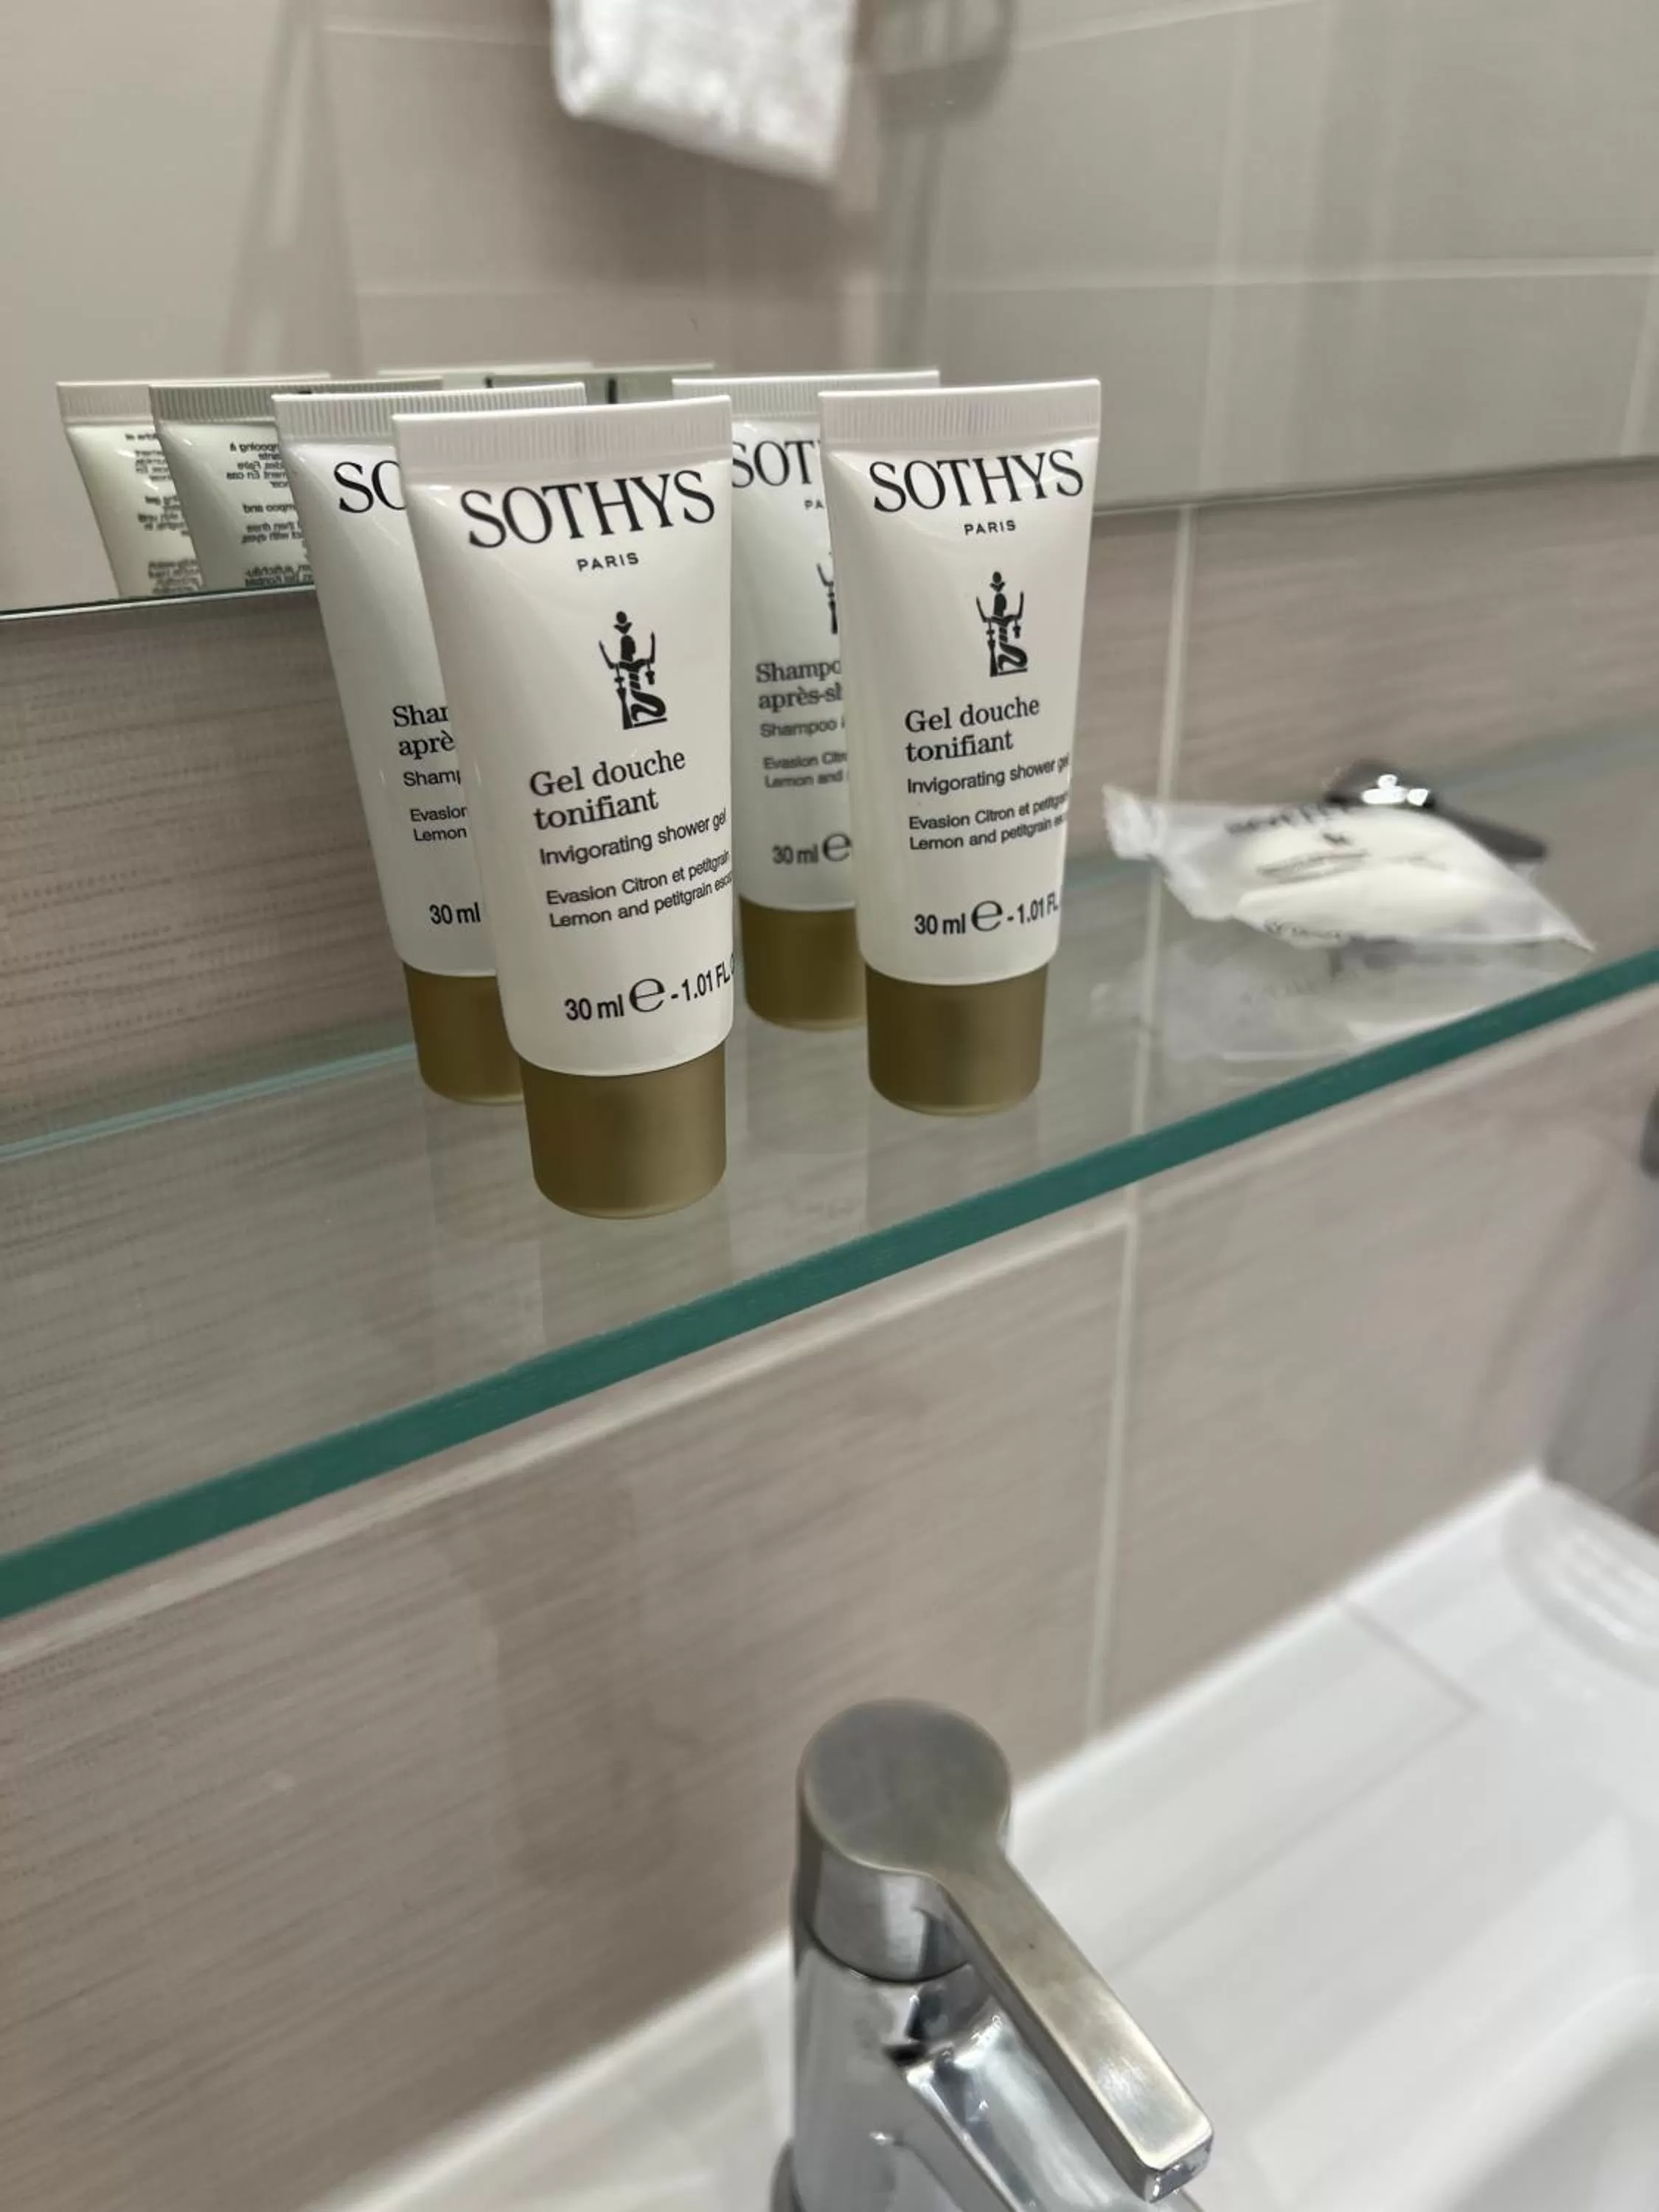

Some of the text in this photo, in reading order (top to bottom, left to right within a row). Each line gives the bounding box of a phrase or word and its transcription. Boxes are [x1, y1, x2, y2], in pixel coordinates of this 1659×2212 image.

[731, 439, 820, 488] SOT
[869, 449, 1084, 512] SOTHYS
[460, 470, 715, 548] SOTHYS
[964, 519, 1016, 535] PARIS
[577, 552, 639, 571] PARIS
[759, 718, 838, 737] Shampoo
[905, 695, 1040, 733] Gel douche
[399, 730, 456, 760] aprè
[905, 729, 1014, 762] tonifiant
[403, 769, 461, 787] Sham
[530, 750, 686, 796] Gel douche
[908, 771, 1005, 795] Invigorating
[1010, 758, 1056, 781] shower
[534, 787, 659, 830] tonifiant
[908, 814, 970, 830] Evasion
[975, 807, 1015, 825] Citron
[414, 827, 467, 841] Lemon
[540, 807, 727, 865] Invigorating shower gel
[910, 837, 964, 850] Lemon
[969, 830, 997, 846] and
[772, 844, 793, 864] 30
[796, 844, 818, 864] ml
[546, 884, 616, 905] Evasion
[622, 872, 667, 894] Citron
[672, 867, 685, 883] et
[429, 902, 481, 925] 30 ml
[549, 910, 612, 928] Lemon
[618, 900, 650, 919] and
[655, 883, 713, 914] petitgrain
[914, 914, 939, 935] 30
[942, 912, 966, 935] ml
[564, 998, 592, 1020] 30
[597, 993, 625, 1018] ml
